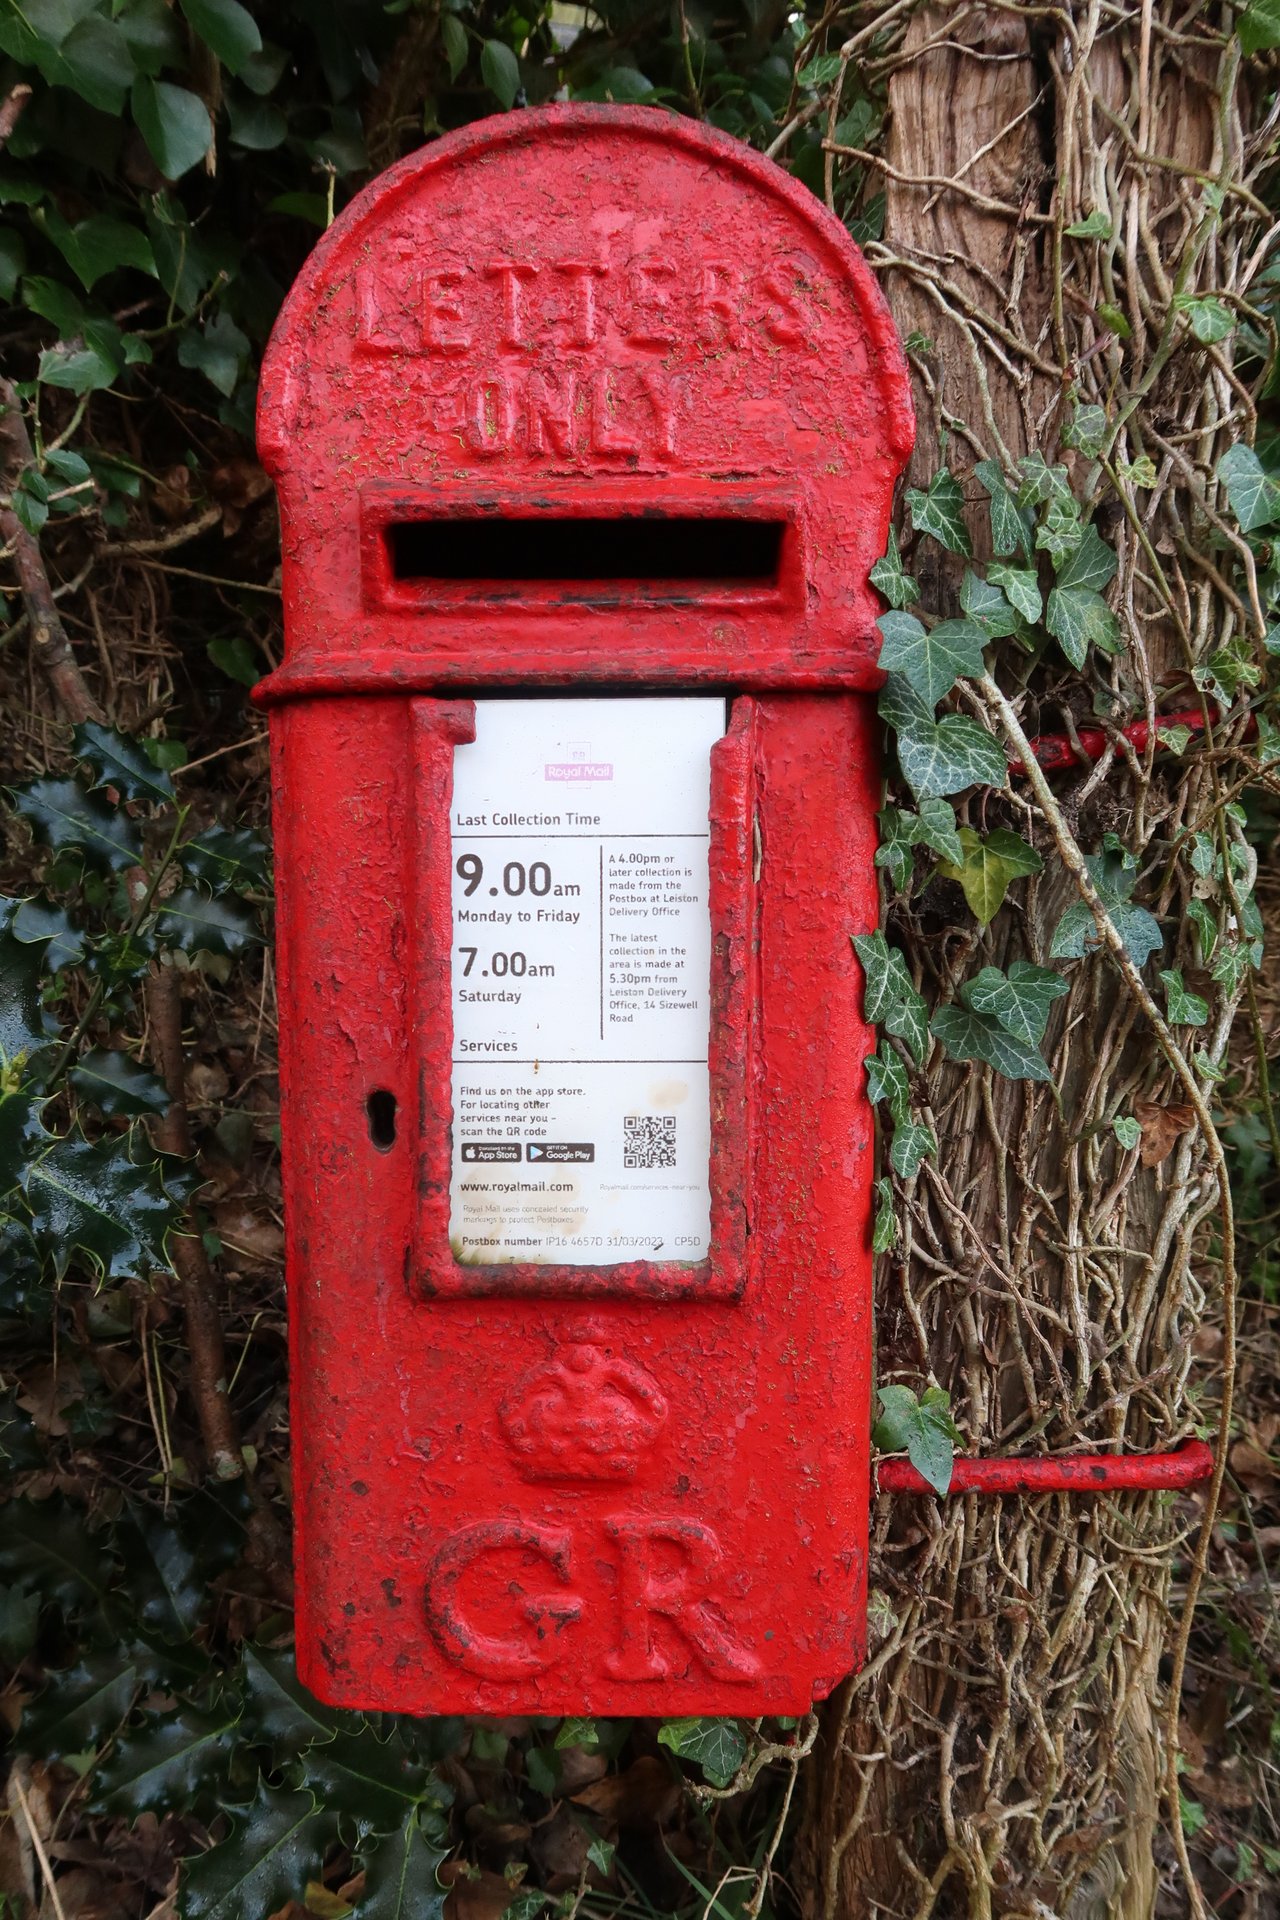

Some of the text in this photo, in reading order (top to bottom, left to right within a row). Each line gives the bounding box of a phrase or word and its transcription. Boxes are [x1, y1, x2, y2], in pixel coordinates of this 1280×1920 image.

[350, 256, 808, 360] LETTERS
[463, 366, 688, 462] ONLY
[548, 765, 610, 780] Royal Mail
[457, 813, 600, 826] Last Collection Time
[609, 855, 615, 863] A
[619, 853, 660, 865] 4.00pm
[456, 854, 580, 897] 9.00am
[609, 868, 692, 877] later collection is
[609, 881, 681, 890] made from the
[609, 894, 646, 903] Postbox
[664, 894, 698, 902] Leiston
[458, 909, 580, 924] Monday to Friday
[609, 907, 680, 917] Delivery Office
[609, 934, 658, 942] The latest
[609, 946, 686, 955] collection in the
[458, 947, 554, 977] 7.00am
[634, 960, 641, 968] is
[645, 960, 671, 968] made
[610, 973, 678, 985] 5.30pm from
[459, 990, 521, 1004] Saturday
[610, 987, 687, 998] Leiston Delivery
[610, 1000, 698, 1010] Office, 14 Sizewell
[610, 1014, 633, 1022] Road
[460, 1039, 517, 1052] Services
[461, 1086, 481, 1095] Find
[516, 1087, 532, 1095] the
[536, 1089, 553, 1097] app
[461, 1100, 550, 1111] For locating other
[460, 1114, 500, 1122] services
[530, 1116, 548, 1124] you
[486, 1127, 502, 1136] the
[507, 1127, 520, 1136] QR
[524, 1127, 547, 1136] code
[478, 1151, 518, 1160] App Store
[546, 1150, 591, 1160] Google Play
[460, 1181, 573, 1193] www.royalmail.com
[463, 1204, 483, 1214] Royal
[485, 1204, 500, 1212] Mail
[521, 1204, 558, 1213] concealed
[560, 1204, 589, 1214] security
[500, 1216, 507, 1224] to
[508, 1215, 535, 1225] protect
[462, 1236, 500, 1246] Postbox
[504, 1237, 542, 1246] number
[546, 1236, 567, 1246] IP16
[674, 1236, 701, 1246] CP5D
